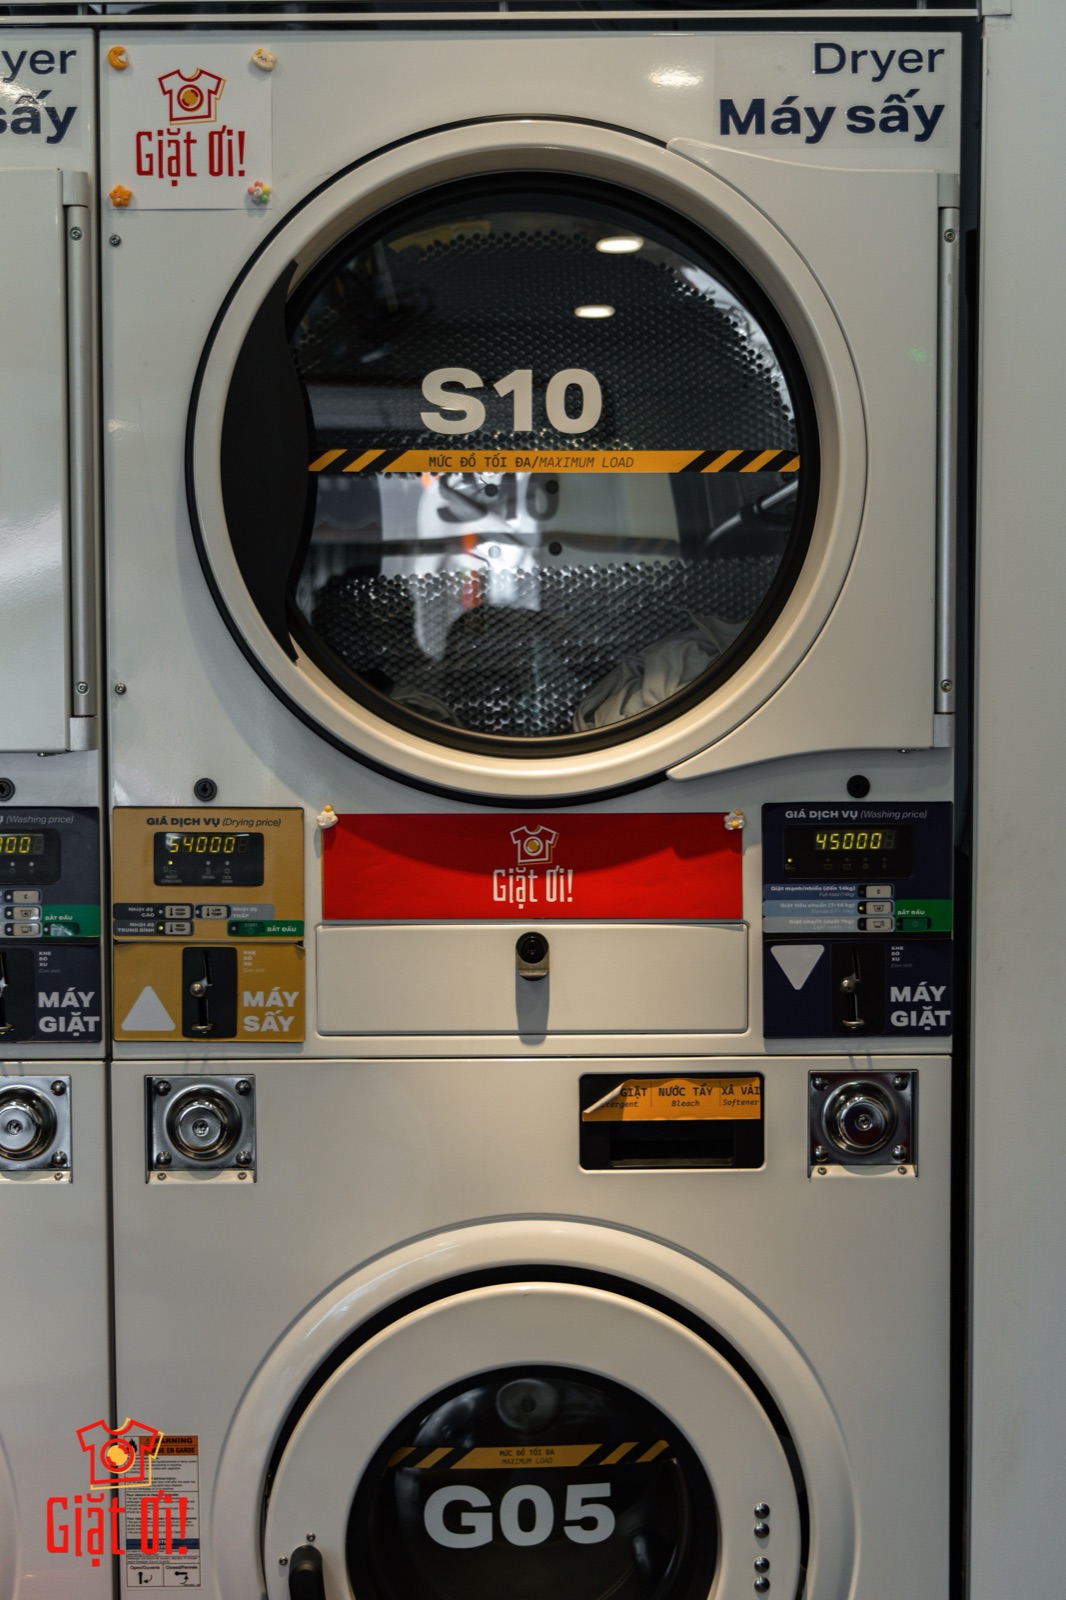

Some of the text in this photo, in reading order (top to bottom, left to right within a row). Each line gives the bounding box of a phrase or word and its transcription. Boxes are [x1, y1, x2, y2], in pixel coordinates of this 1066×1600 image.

[814, 42, 945, 82] Dryer
[719, 88, 945, 144] Máy sấy
[135, 125, 246, 187] Giặt Ơi!
[420, 367, 602, 435] S10
[428, 454, 452, 468] MỨC
[484, 452, 507, 468] TỐI
[601, 456, 634, 468] LOAD
[6, 815, 47, 825] (Washing
[48, 815, 74, 824] price)
[146, 816, 282, 828] GIÁ DỊCH VỤ (Drying price)
[785, 808, 928, 820] GIÁ DỊCH VỤ (Washing price)
[169, 836, 236, 853] 54000
[815, 833, 882, 850] 45000
[493, 865, 573, 909] Giặt Ơi!
[38, 987, 95, 1008] MÁY
[243, 987, 300, 1008] MÁY
[890, 981, 947, 1003] MÁY
[38, 1012, 100, 1036] GIẶT
[243, 1010, 294, 1032] SẤY
[890, 1006, 951, 1031] GIẶT
[620, 1085, 648, 1099] GIẶT
[658, 1084, 686, 1097] NƯỚC
[601, 1101, 639, 1109] tergent
[671, 1099, 700, 1107] Bleach
[722, 1098, 760, 1107] Softener
[535, 1457, 554, 1465] LOAD
[424, 1482, 615, 1549] G05
